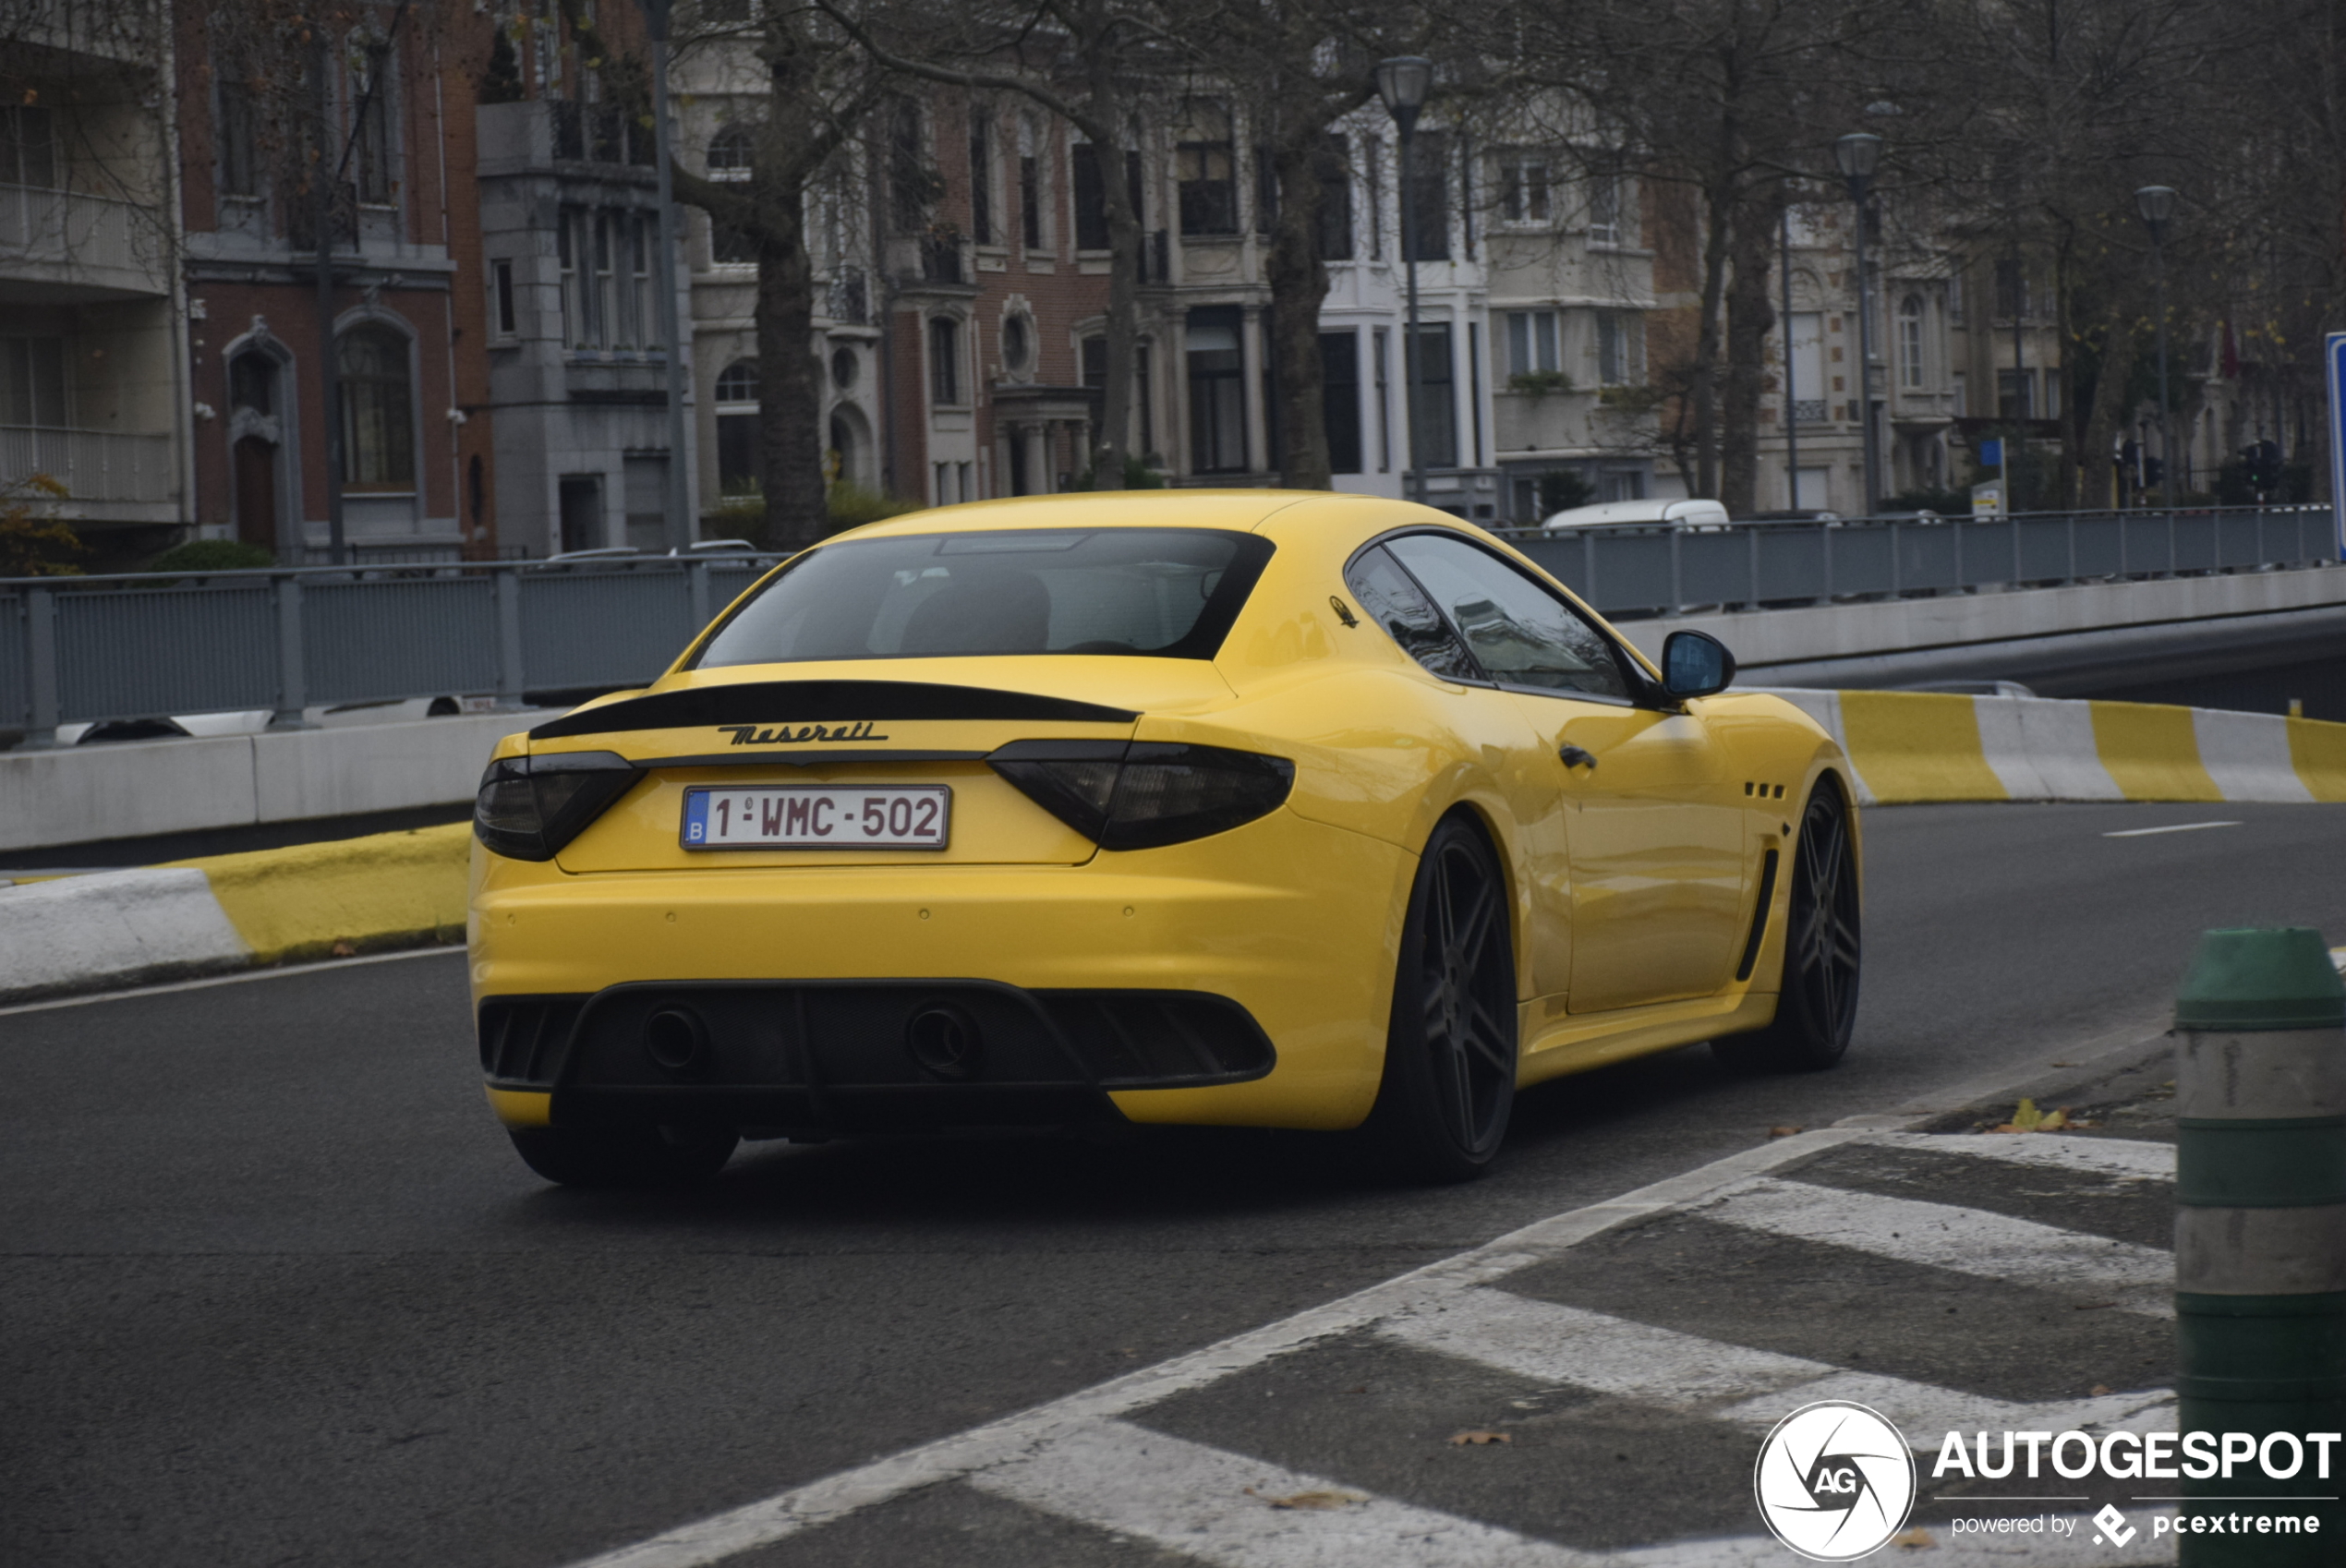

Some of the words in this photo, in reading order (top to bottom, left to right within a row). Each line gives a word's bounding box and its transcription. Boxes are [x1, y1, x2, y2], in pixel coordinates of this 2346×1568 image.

[718, 722, 889, 745] Maserati
[716, 797, 938, 837] 1-WMC-502
[690, 823, 703, 840] B
